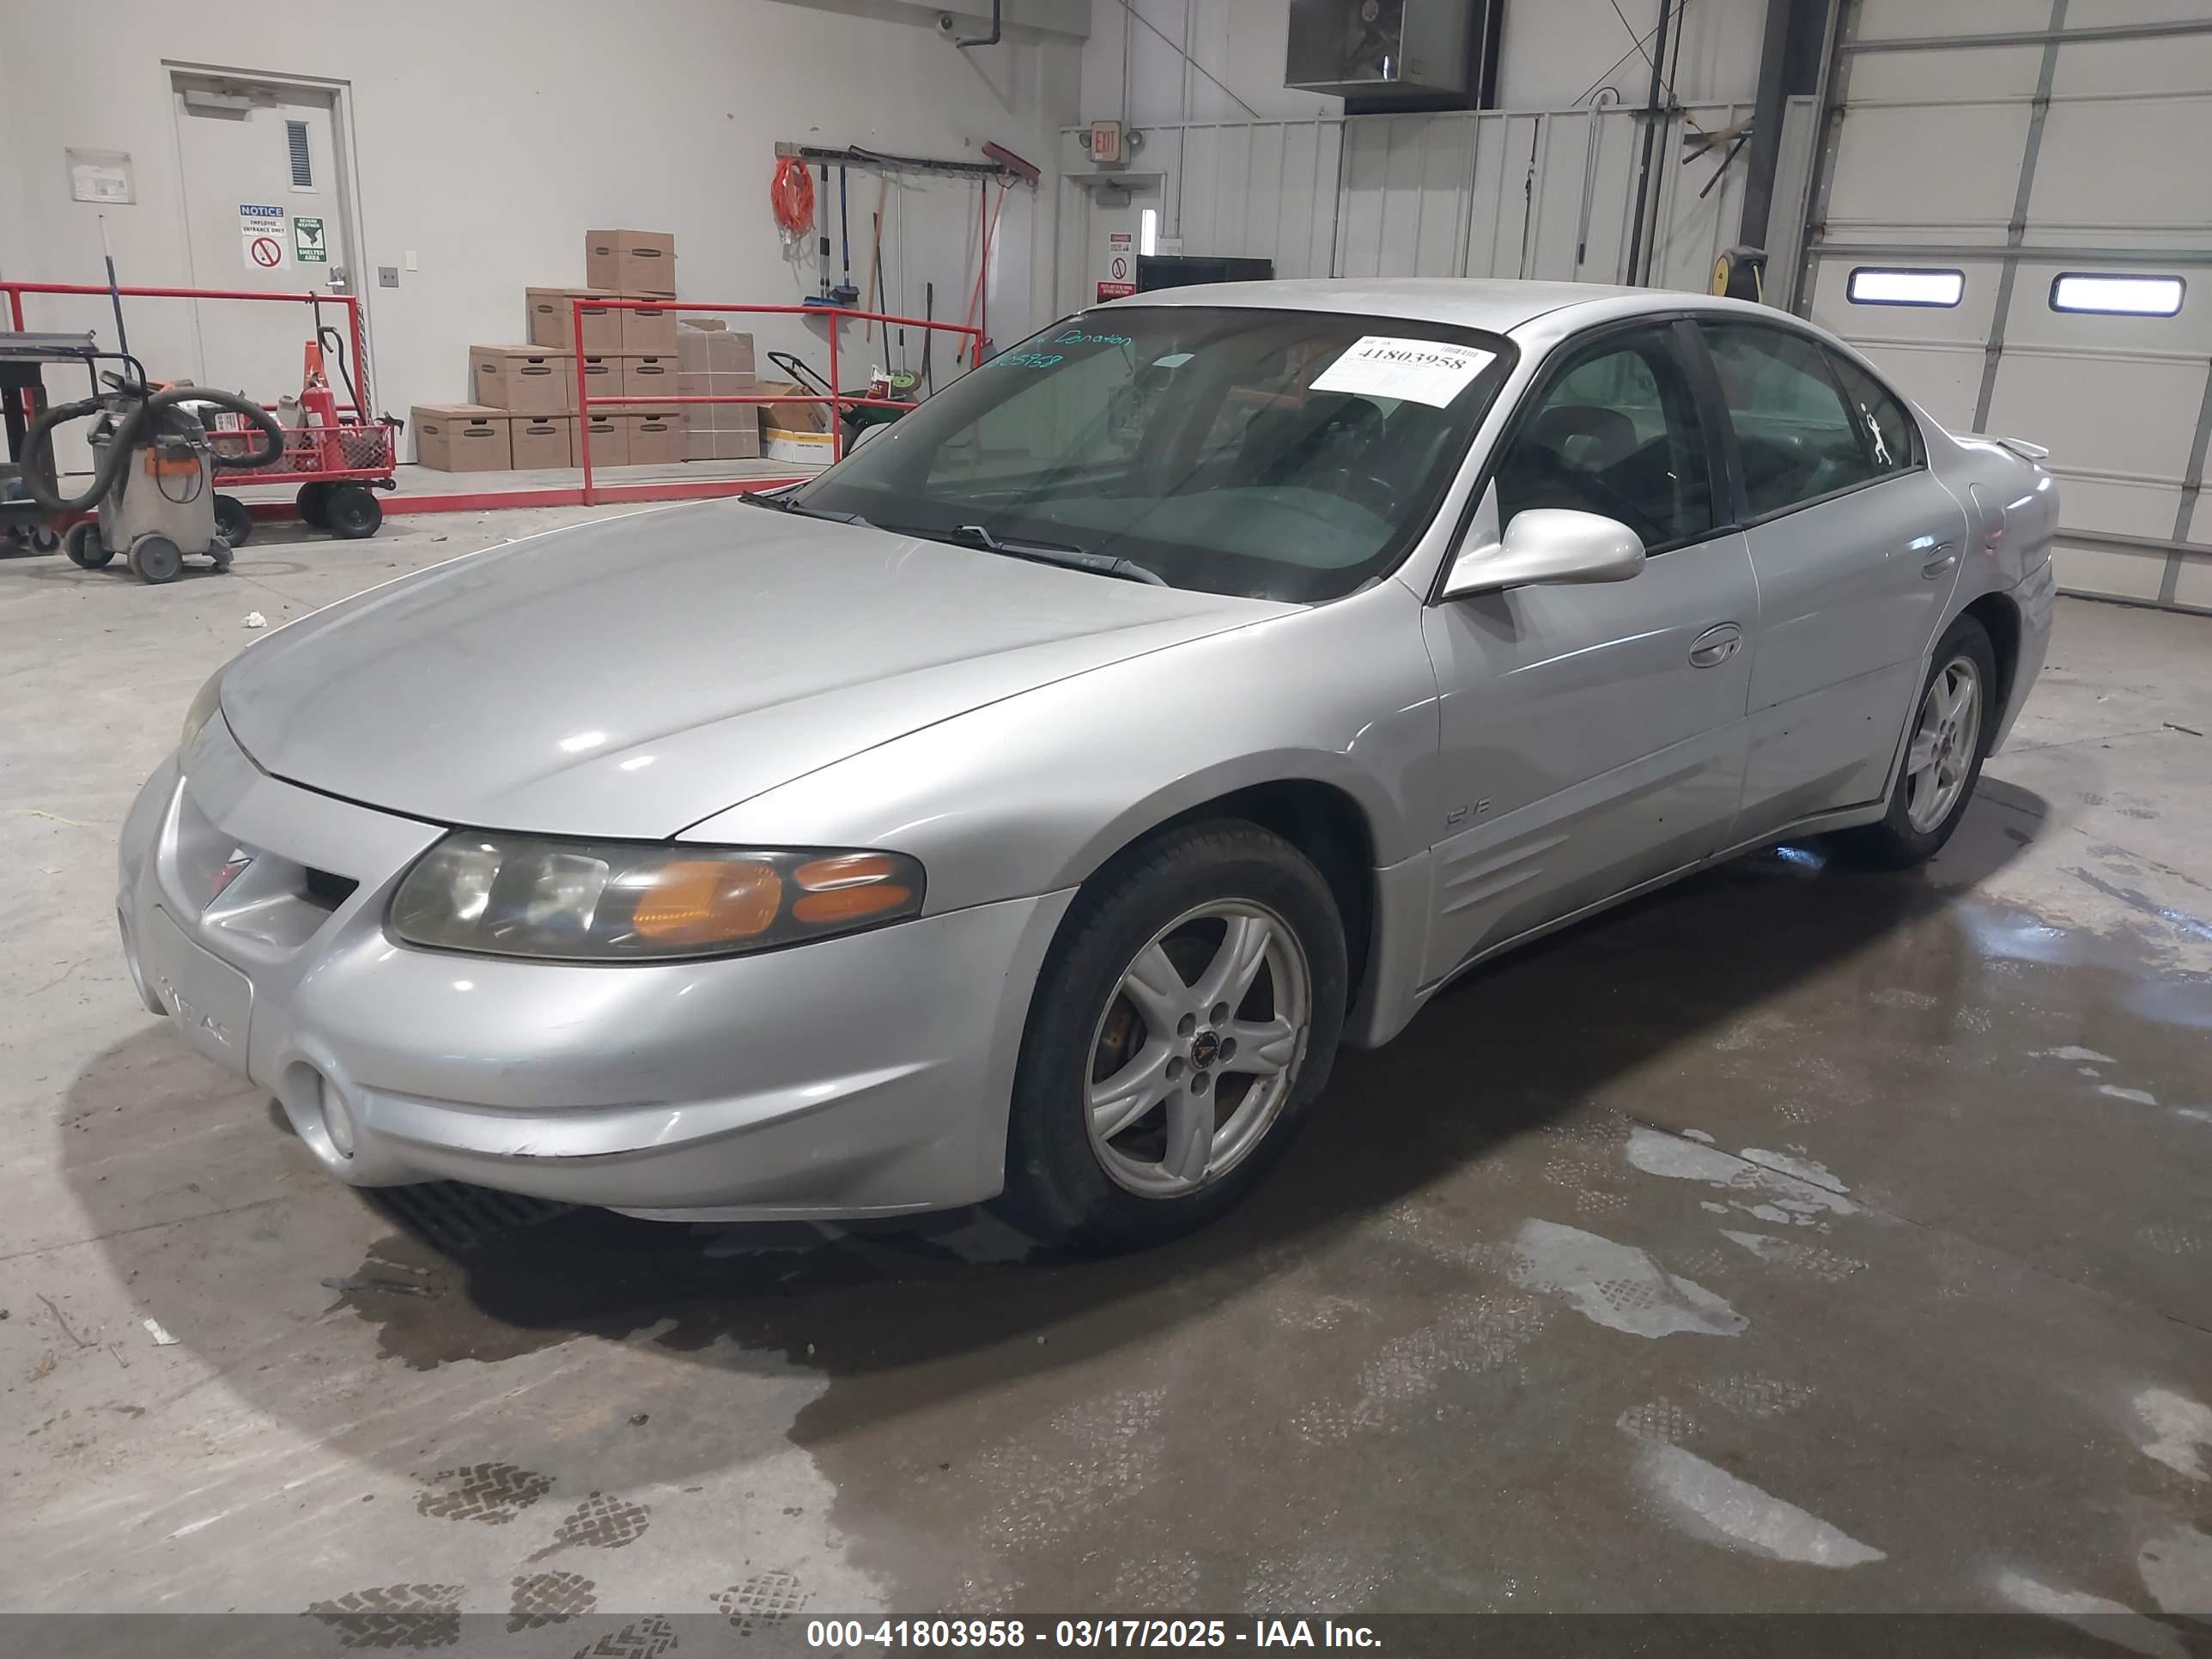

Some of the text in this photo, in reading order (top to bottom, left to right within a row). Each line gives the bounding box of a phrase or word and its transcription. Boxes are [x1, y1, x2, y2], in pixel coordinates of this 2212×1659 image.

[1095, 131, 1115, 153] EXIT
[241, 206, 283, 216] NOTICE
[1055, 330, 1132, 345] Donation
[1358, 348, 1467, 370] 41803958
